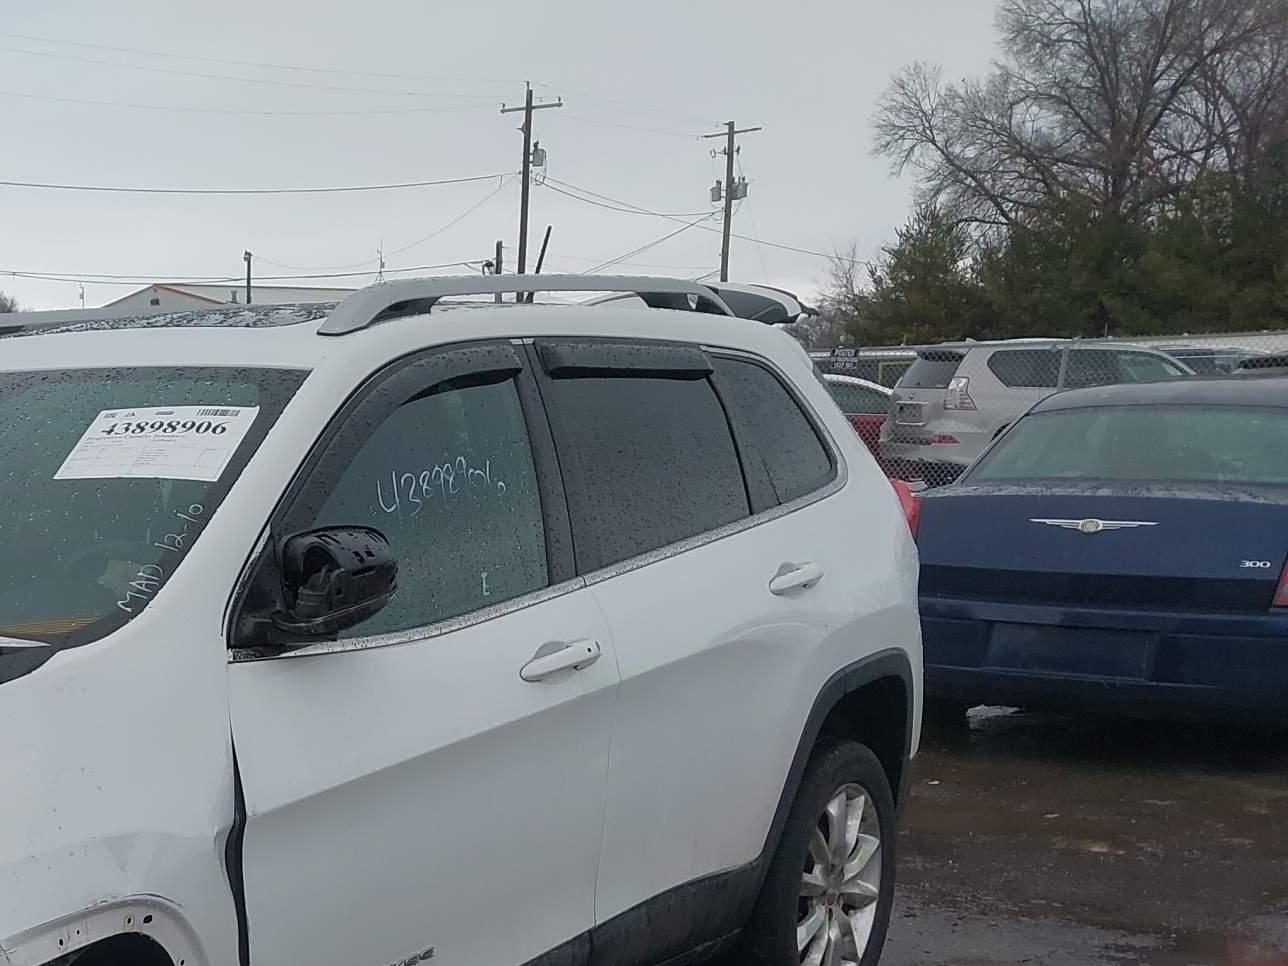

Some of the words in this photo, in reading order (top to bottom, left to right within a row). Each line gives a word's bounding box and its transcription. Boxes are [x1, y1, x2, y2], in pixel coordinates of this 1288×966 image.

[101, 420, 231, 436] 43898906
[117, 564, 164, 613] MAD
[154, 503, 203, 552] 12-10
[1239, 560, 1272, 568] 300
